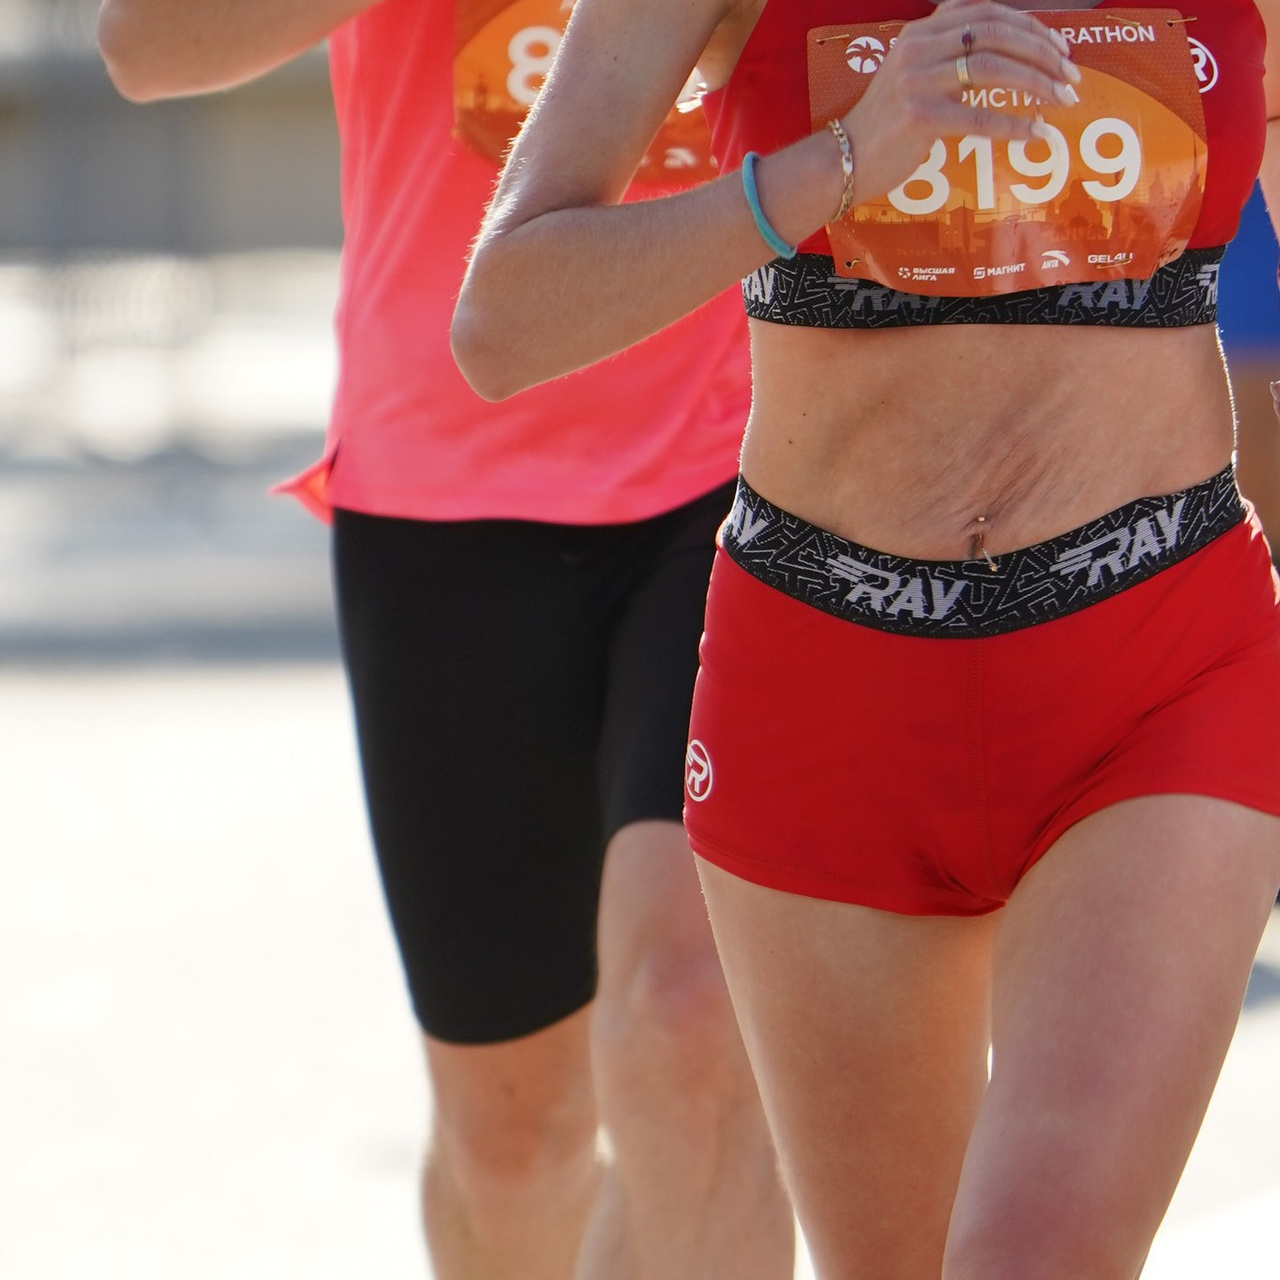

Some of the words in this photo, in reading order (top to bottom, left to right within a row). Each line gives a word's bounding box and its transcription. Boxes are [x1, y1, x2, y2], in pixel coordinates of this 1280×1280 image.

[1050, 25, 1155, 45] RATHON
[961, 83, 1080, 109] ИСТИА
[887, 117, 1142, 215] 8199
[987, 263, 1026, 276] МАГНИТ
